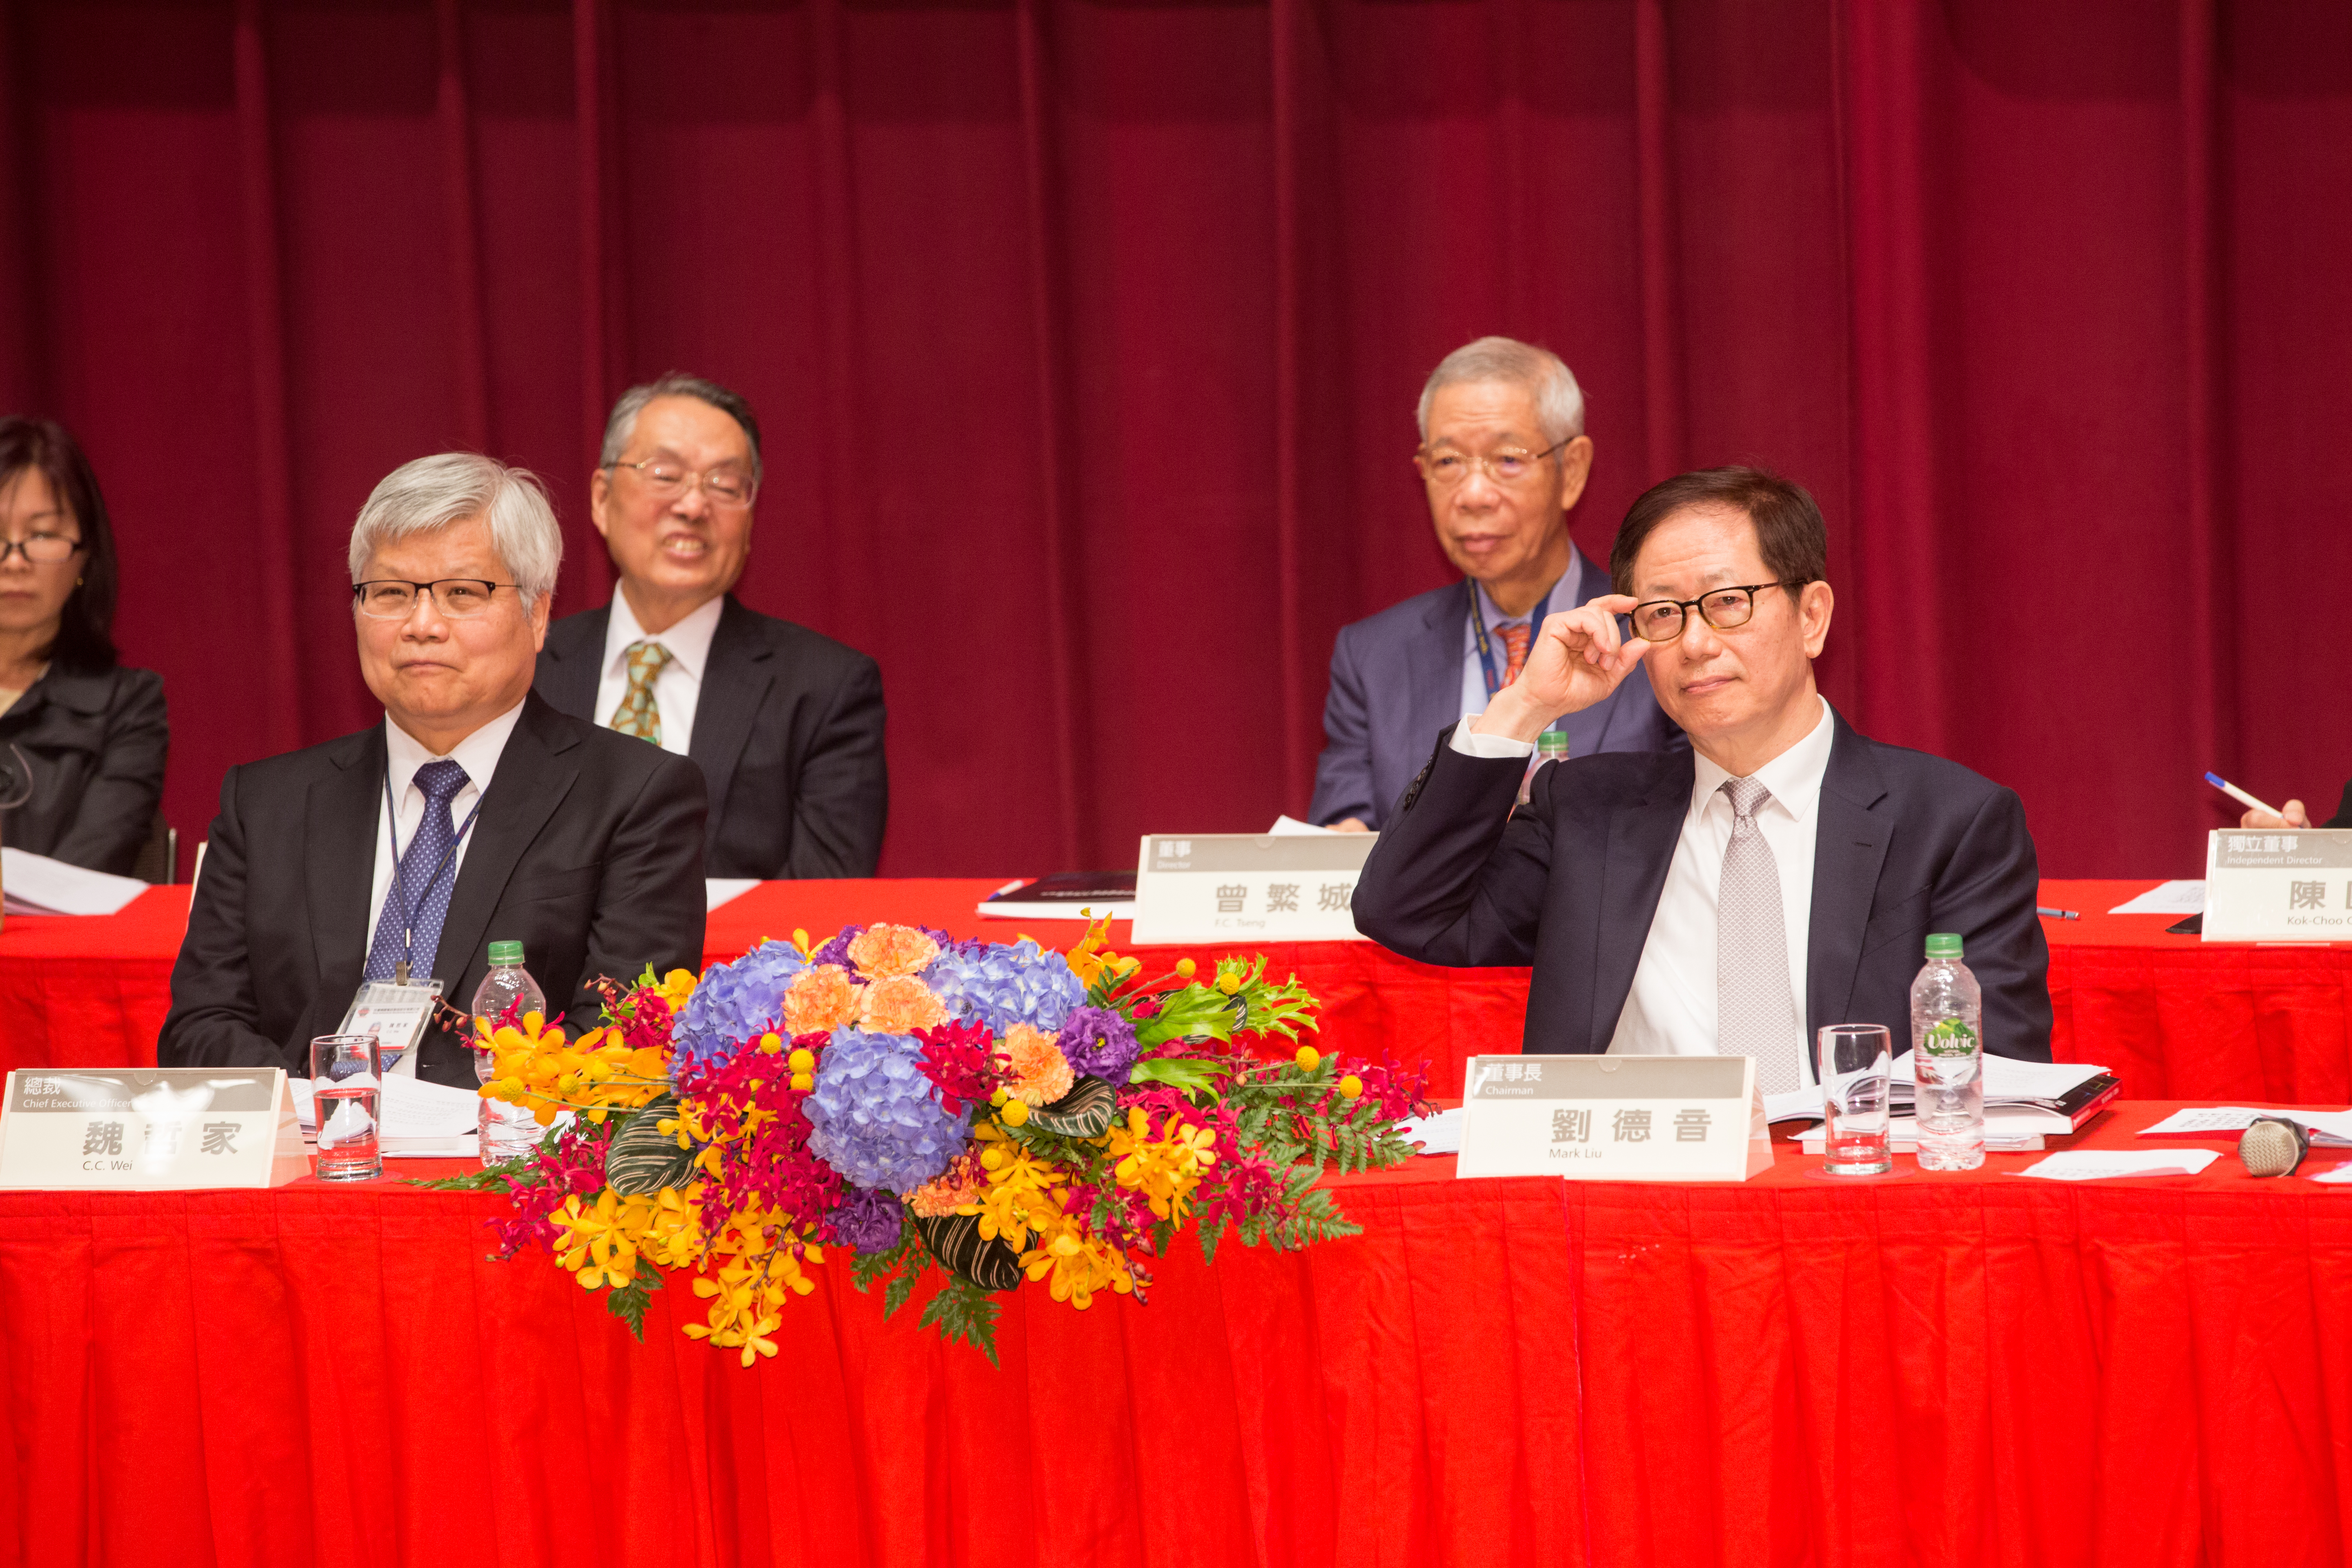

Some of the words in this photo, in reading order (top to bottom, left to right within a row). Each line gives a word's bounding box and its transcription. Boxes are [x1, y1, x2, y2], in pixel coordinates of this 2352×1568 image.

[1158, 840, 1192, 858] 董事
[2228, 835, 2299, 853] 獨立董事
[1157, 860, 1191, 869] Director
[2227, 856, 2284, 866] Independent
[2287, 855, 2323, 864] Director
[1216, 883, 1352, 913] 曾繁城
[2290, 880, 2352, 910] 陳
[1237, 919, 1265, 929] Tseng
[2287, 915, 2343, 925] Kok-Choo
[1928, 1033, 1975, 1049] Volvic
[1485, 1063, 1542, 1082] 董事長
[23, 1077, 61, 1095] 總裁
[1486, 1085, 1534, 1095] Chairman
[23, 1098, 50, 1108] Chief
[51, 1099, 96, 1108] Executive
[98, 1098, 132, 1108] Officer
[1551, 1109, 1712, 1143] 劉德音
[1549, 1148, 1580, 1158] Mark
[1585, 1148, 1602, 1158] Liu
[82, 1160, 105, 1170] C.C.
[111, 1160, 133, 1170] Wei
